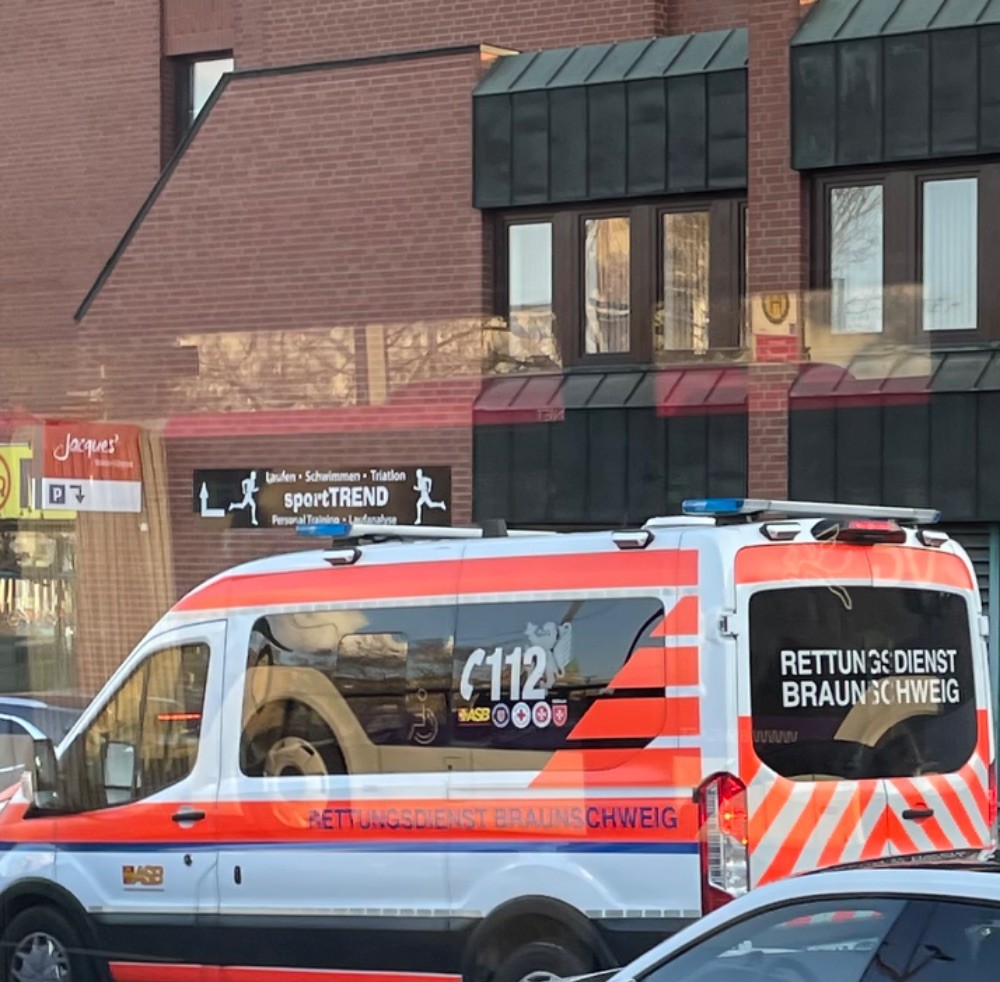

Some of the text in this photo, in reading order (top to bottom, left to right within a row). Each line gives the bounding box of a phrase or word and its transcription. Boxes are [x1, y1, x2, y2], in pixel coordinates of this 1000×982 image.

[265, 470, 297, 484] Laufen
[304, 469, 361, 483] Schwimmen
[283, 485, 390, 513] sportTREND
[485, 645, 548, 701] 112
[308, 808, 488, 831] RETTUNGSDIENST
[494, 806, 678, 831] BRAUNSCHWEIG
